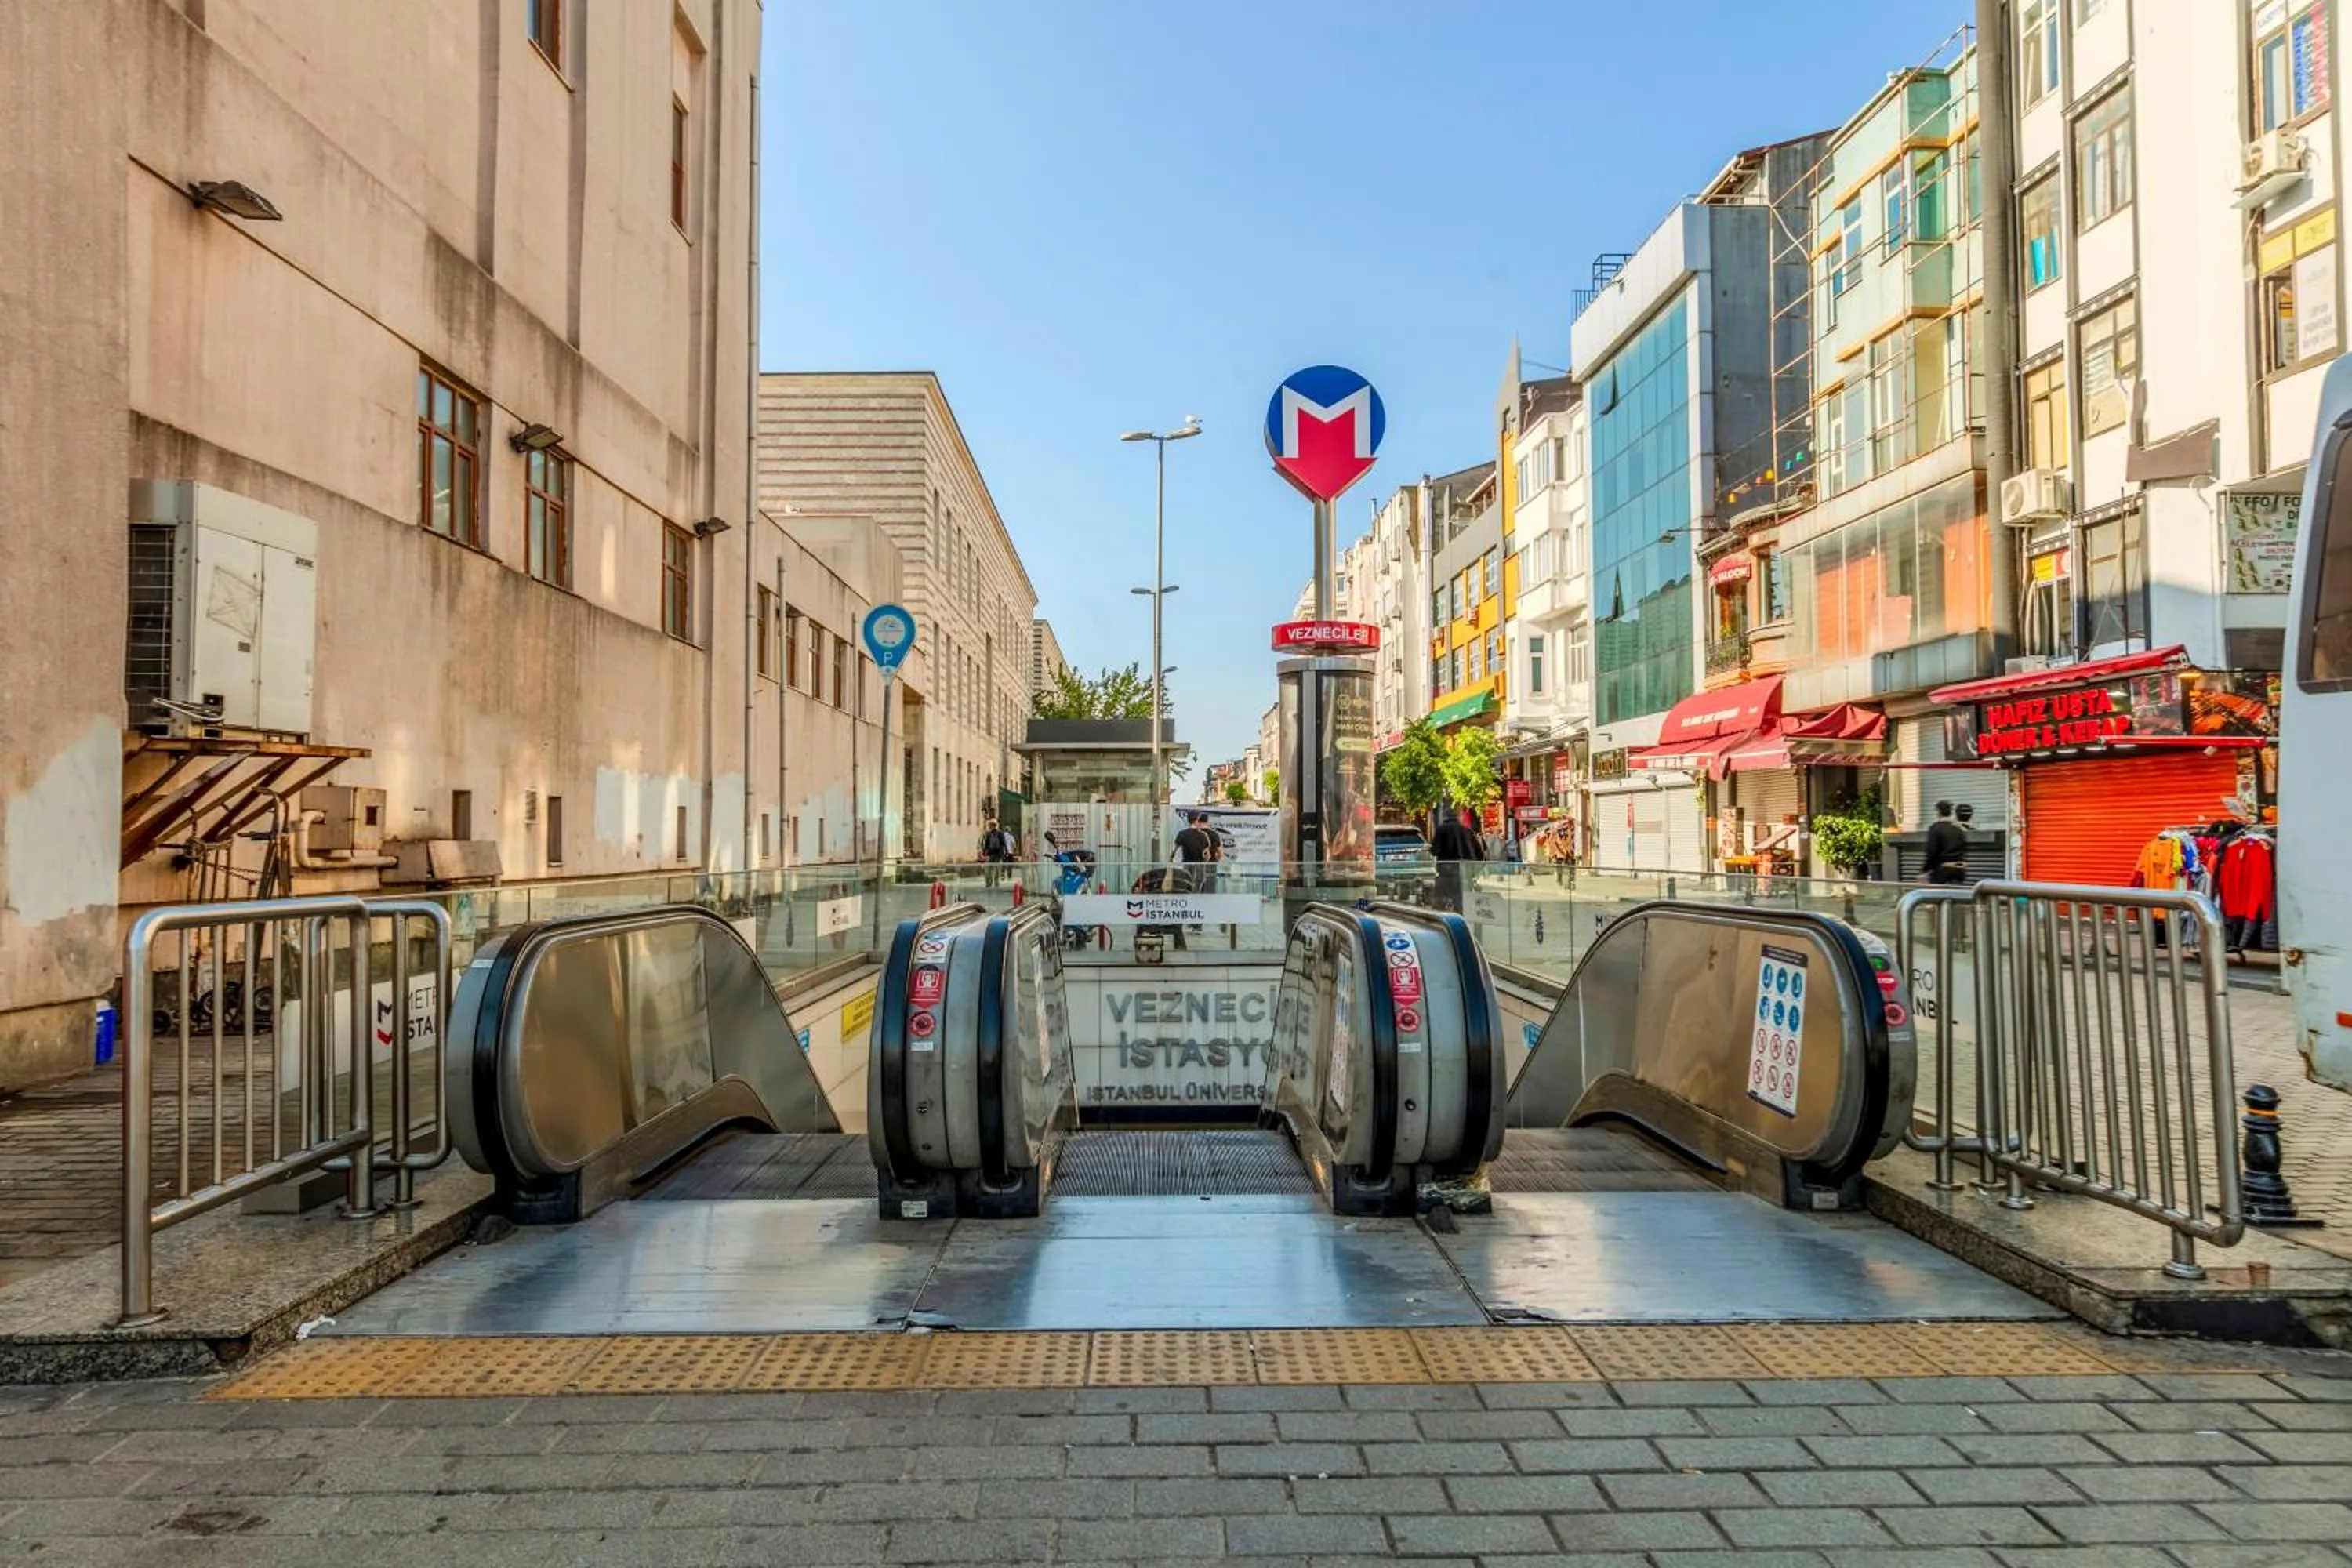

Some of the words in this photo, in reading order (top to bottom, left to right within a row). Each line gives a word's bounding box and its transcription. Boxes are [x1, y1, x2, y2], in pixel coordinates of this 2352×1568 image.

[1287, 624, 1368, 641] VEZNECİLER
[1989, 699, 2047, 728] HAFIZ
[2052, 688, 2113, 719] USTA
[1145, 899, 1189, 909] METRO
[1913, 997, 1936, 1019] NB
